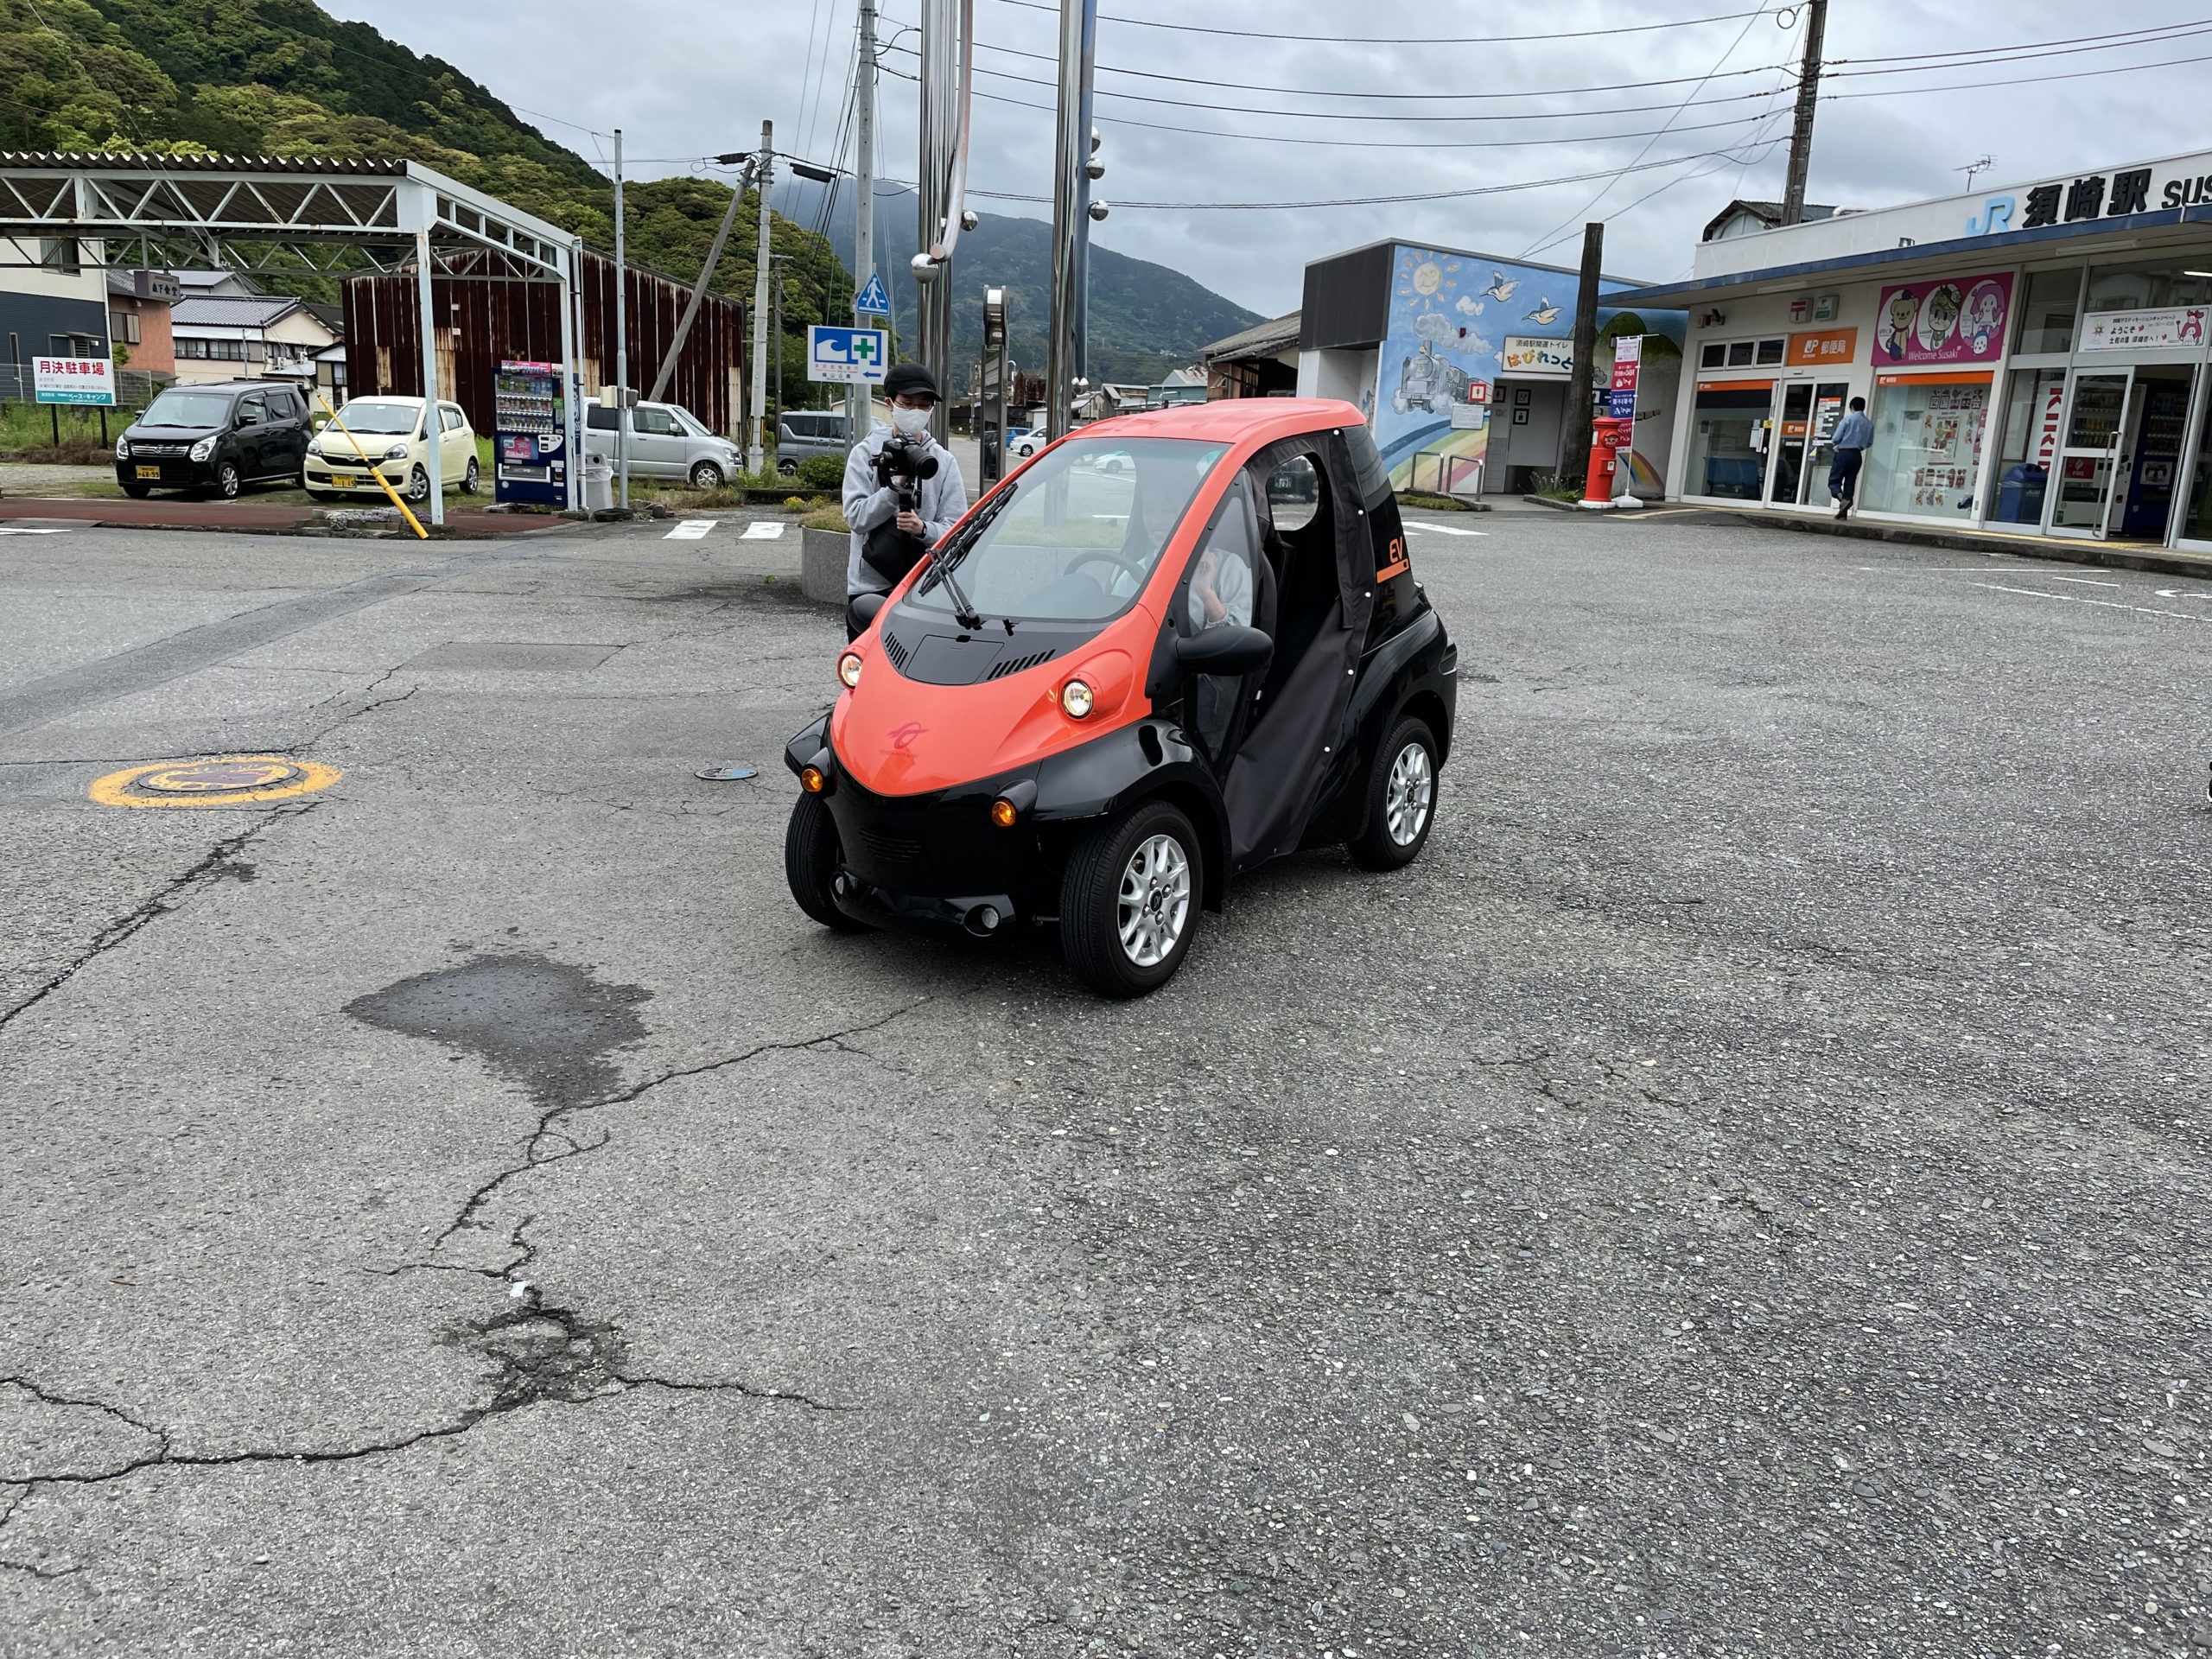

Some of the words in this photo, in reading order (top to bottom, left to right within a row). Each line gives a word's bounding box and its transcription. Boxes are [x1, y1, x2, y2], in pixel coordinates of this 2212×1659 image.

[1965, 195, 2015, 237] JR
[2022, 168, 2152, 229] 須崎駅
[2110, 326, 2136, 334] ようこそ
[1516, 340, 1568, 349] 須崎駅開運トイレ
[1804, 340, 1827, 353] JP
[1821, 340, 1847, 354] 郵便局
[1908, 351, 1936, 361] Welcome
[1937, 349, 1958, 359] Susaki
[40, 360, 105, 376] 月決駐車場
[1389, 536, 1403, 563] EV
